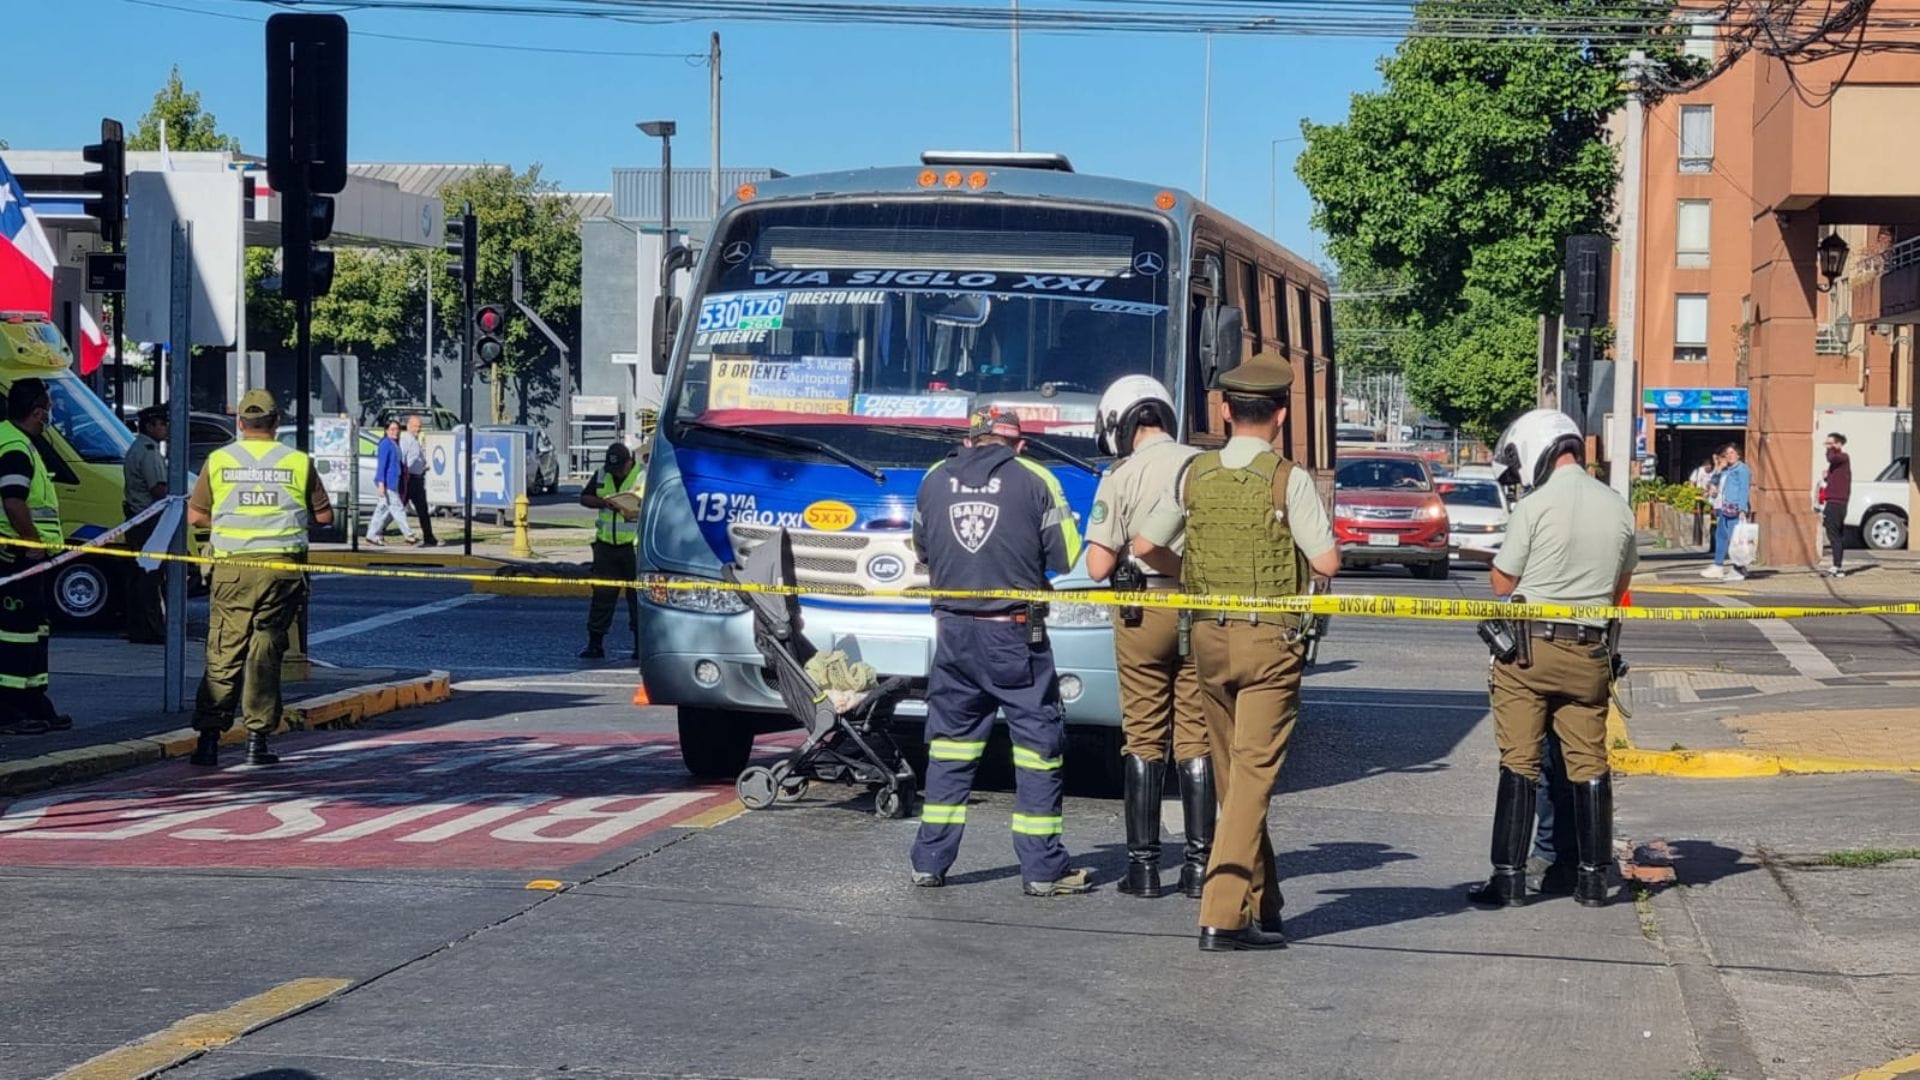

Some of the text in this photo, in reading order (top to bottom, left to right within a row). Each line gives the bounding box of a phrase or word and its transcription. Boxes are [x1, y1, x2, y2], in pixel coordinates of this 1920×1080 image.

[753, 270, 1105, 292] VIA SIGLO XXI
[787, 291, 846, 305] DIRECTO
[846, 291, 886, 305] MALL
[699, 301, 740, 330] 530
[745, 299, 782, 317] 170
[697, 330, 768, 346] 8 ORIENTE
[718, 362, 789, 380] 8 ORIENTE
[787, 373, 848, 387] Autopista
[864, 396, 962, 409] DIRECTO
[242, 492, 275, 505] SIAT
[696, 492, 756, 522] 13 VIA
[953, 504, 995, 518] SAMU
[727, 509, 804, 529] SIGLO XXI
[1338, 598, 1376, 614] PASAR
[1381, 598, 1395, 614] NO
[1411, 600, 1441, 616] CHILE
[1447, 601, 1460, 616] DE
[1465, 602, 1542, 618] CARABINEROS
